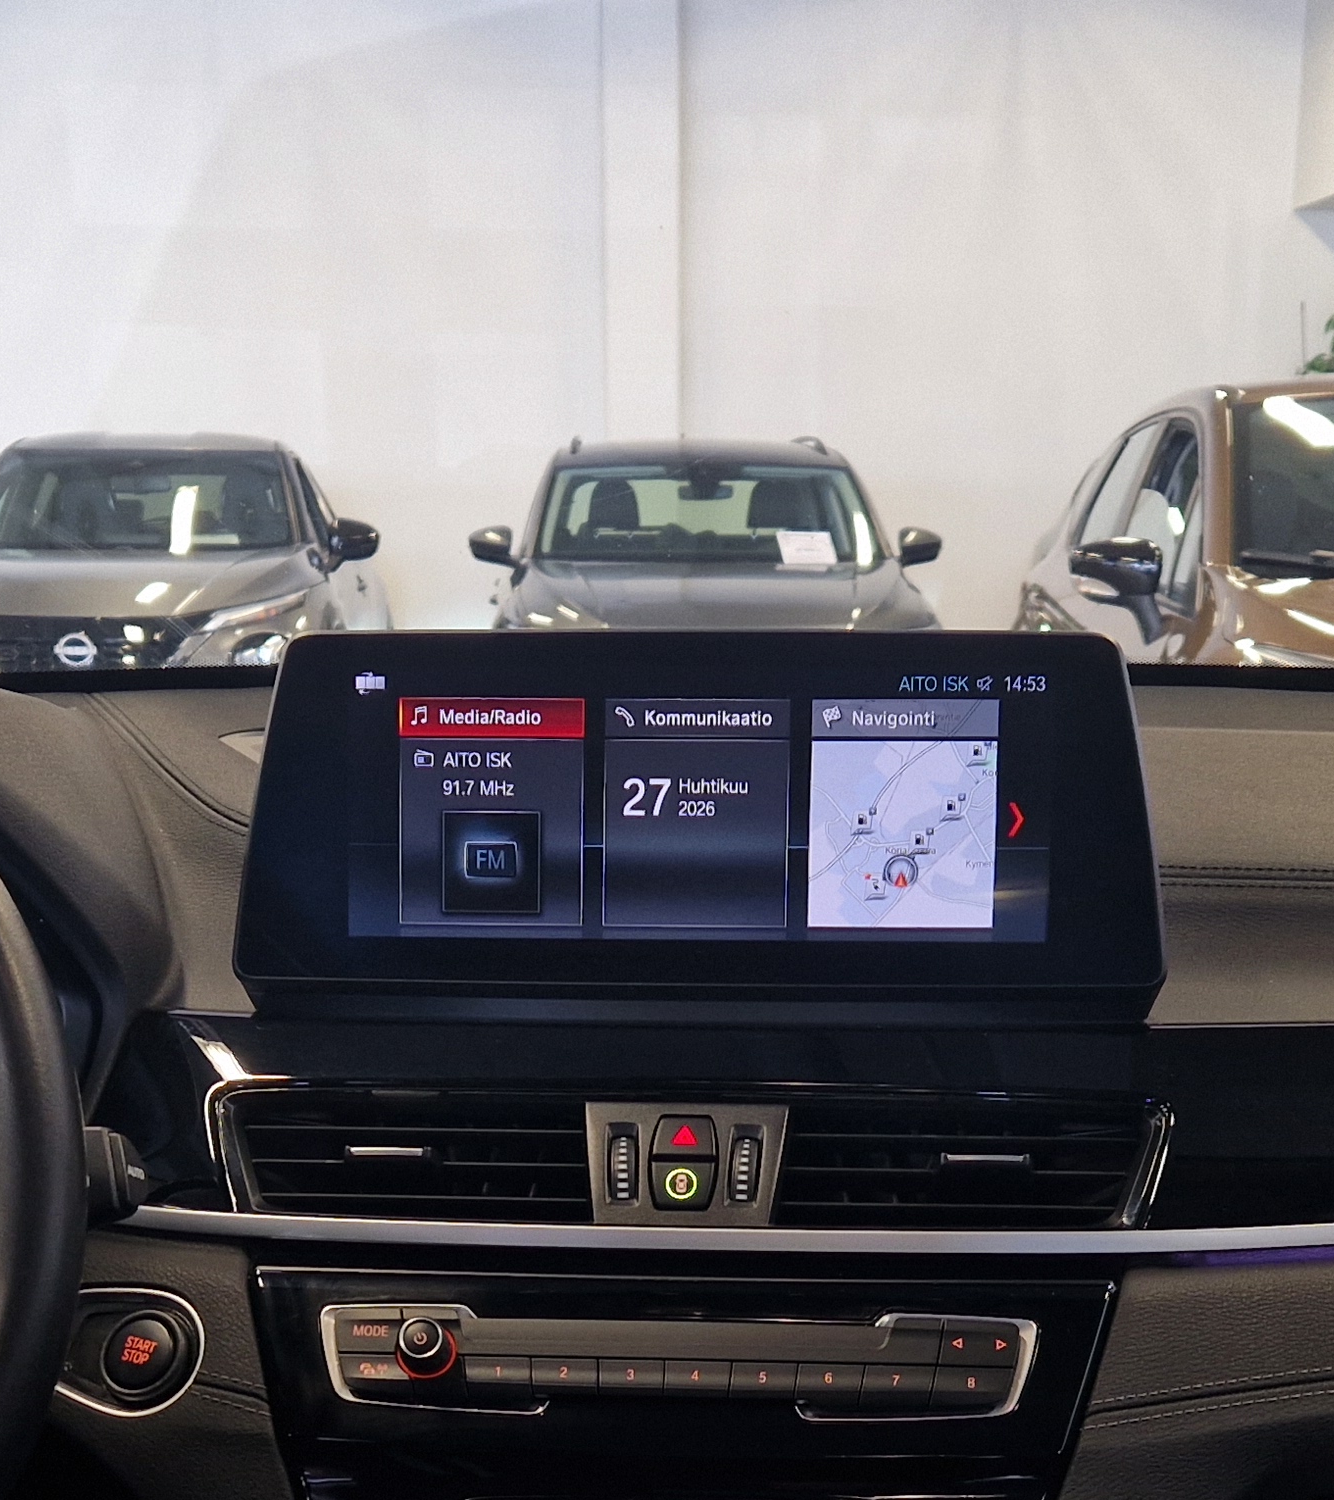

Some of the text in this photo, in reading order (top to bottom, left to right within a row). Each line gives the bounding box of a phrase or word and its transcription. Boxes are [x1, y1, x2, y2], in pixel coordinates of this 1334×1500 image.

[898, 675, 969, 692] AITO ISK
[1003, 675, 1046, 692] 14:53
[439, 708, 542, 725] Media/Radio
[644, 709, 773, 726] Kommunikaatio
[852, 710, 935, 729] Navigointi
[443, 752, 512, 768] AITO ISK
[443, 780, 515, 796] 91.7 MHz
[678, 778, 749, 794] Huhtikuu
[622, 777, 672, 817] 27
[678, 800, 716, 817] 2026
[475, 850, 505, 870] FM
[353, 1324, 389, 1337] MODE
[124, 1335, 158, 1353] START
[121, 1349, 150, 1365] STOP
[495, 1366, 502, 1378] 1
[559, 1366, 568, 1379] 2
[626, 1368, 635, 1381] 3
[690, 1369, 700, 1381] 4
[758, 1371, 767, 1384] 5
[824, 1372, 834, 1385] 6
[892, 1374, 901, 1387] 7
[966, 1376, 976, 1389] 8
